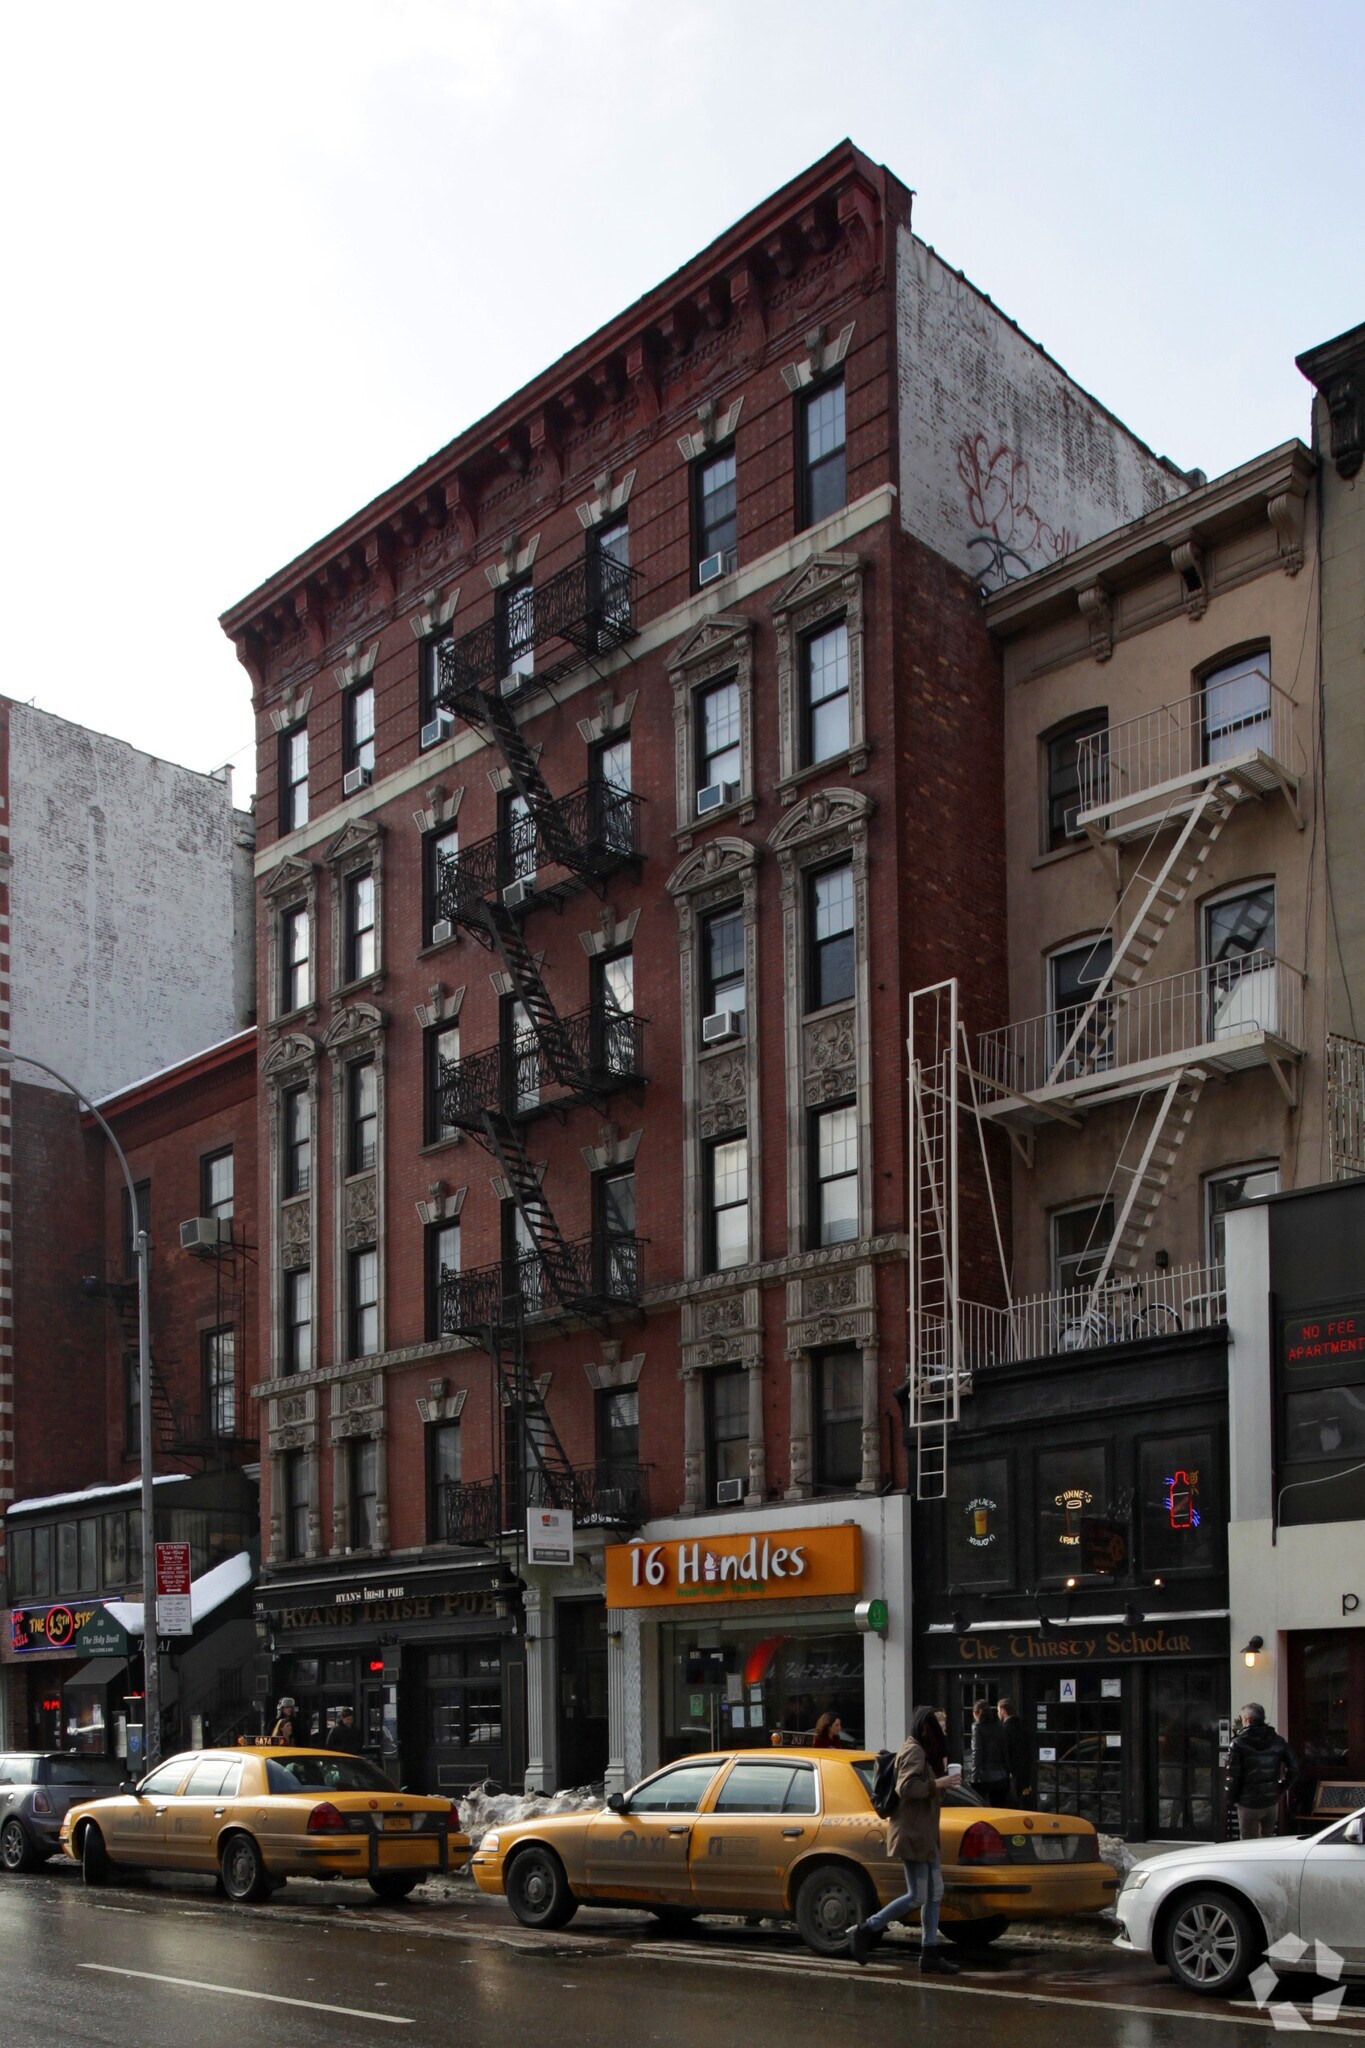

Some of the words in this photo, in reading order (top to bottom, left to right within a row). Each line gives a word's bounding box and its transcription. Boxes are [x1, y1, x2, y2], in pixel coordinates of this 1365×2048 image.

[1302, 1324, 1320, 1339] NO
[1328, 1318, 1356, 1336] FEE
[630, 1545, 668, 1587] 16
[387, 1587, 404, 1598] PUB
[360, 1599, 432, 1623] IRISH
[442, 1593, 497, 1616] PUB
[1342, 1593, 1359, 1616] p
[29, 1617, 46, 1633] THE
[958, 1637, 1000, 1660] The
[1063, 1682, 1073, 1696] A
